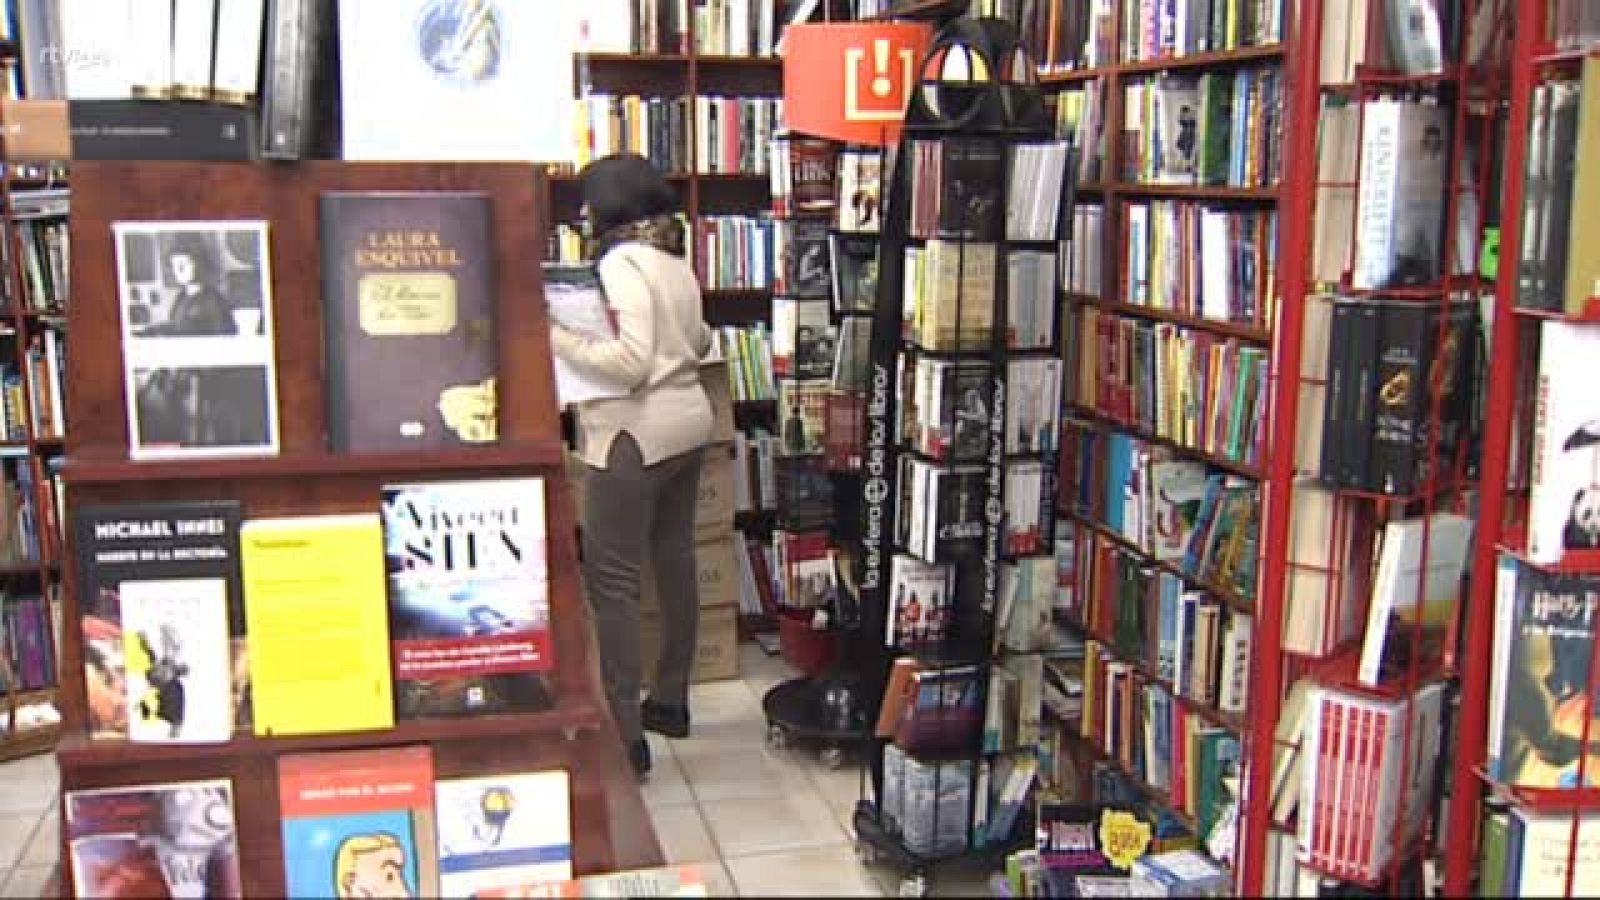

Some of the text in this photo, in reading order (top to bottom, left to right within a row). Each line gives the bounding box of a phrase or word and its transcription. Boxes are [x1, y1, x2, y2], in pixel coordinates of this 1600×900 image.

[367, 231, 440, 248] LAURA
[355, 249, 461, 268] ESQUIVEL
[868, 364, 890, 417] libros
[868, 419, 887, 447] los
[867, 450, 885, 476] de
[94, 519, 173, 541] MICHAEL
[862, 507, 882, 568] esfera
[862, 570, 880, 590] la
